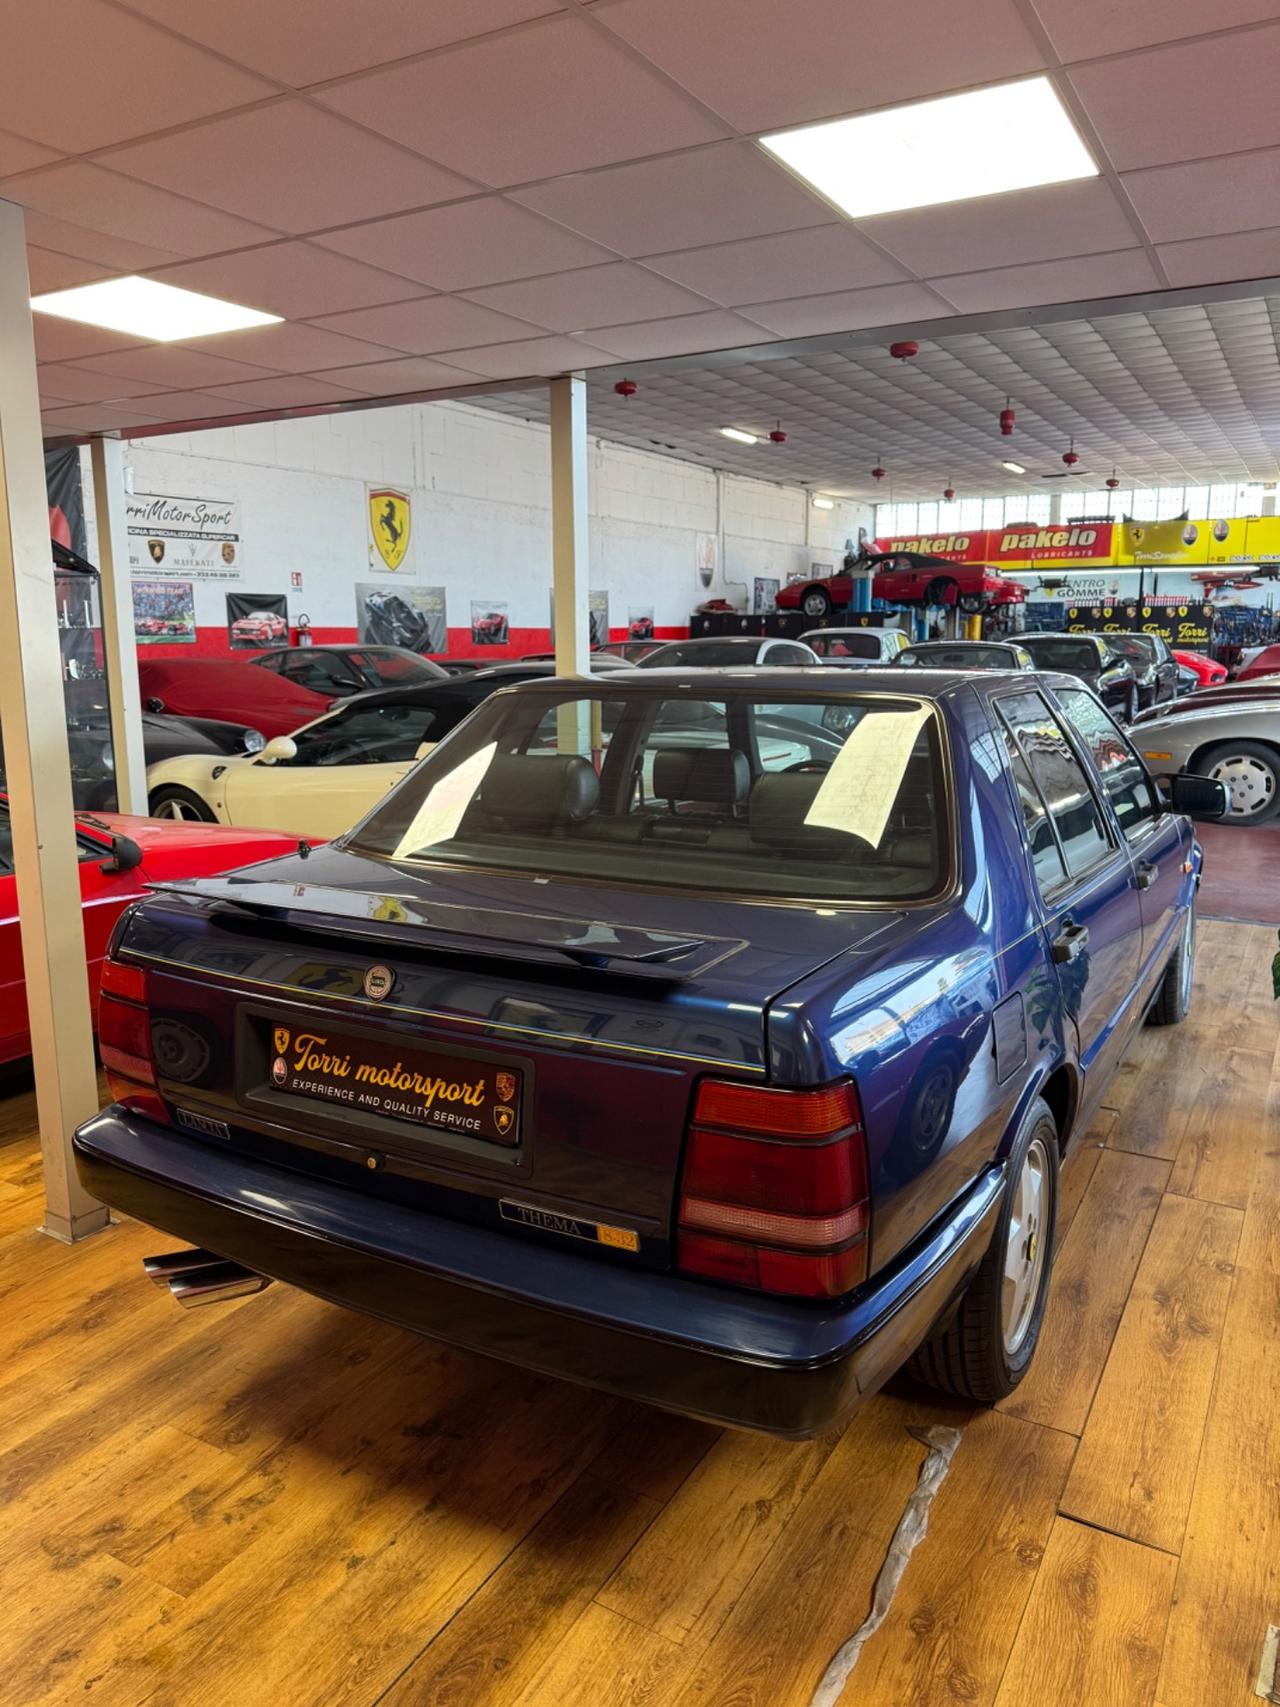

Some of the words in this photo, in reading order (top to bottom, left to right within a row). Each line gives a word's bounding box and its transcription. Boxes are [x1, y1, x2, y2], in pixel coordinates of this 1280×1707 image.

[127, 500, 232, 530] rriMotorSport
[1000, 528, 1097, 552] pakelo
[173, 558, 215, 567] MASERATI
[1030, 549, 1094, 560] LUBRICANTS
[1057, 588, 1106, 598] GOMME
[1068, 579, 1105, 588] ENTRO
[1178, 622, 1208, 637] Torri
[294, 1034, 352, 1077] Torri
[355, 1062, 485, 1108] motorsport
[292, 1079, 355, 1101] EXPERIENCE
[358, 1093, 380, 1107] AND
[383, 1099, 430, 1118] QUALITY
[433, 1110, 482, 1130] SERVICE
[517, 1207, 582, 1235] THEMA
